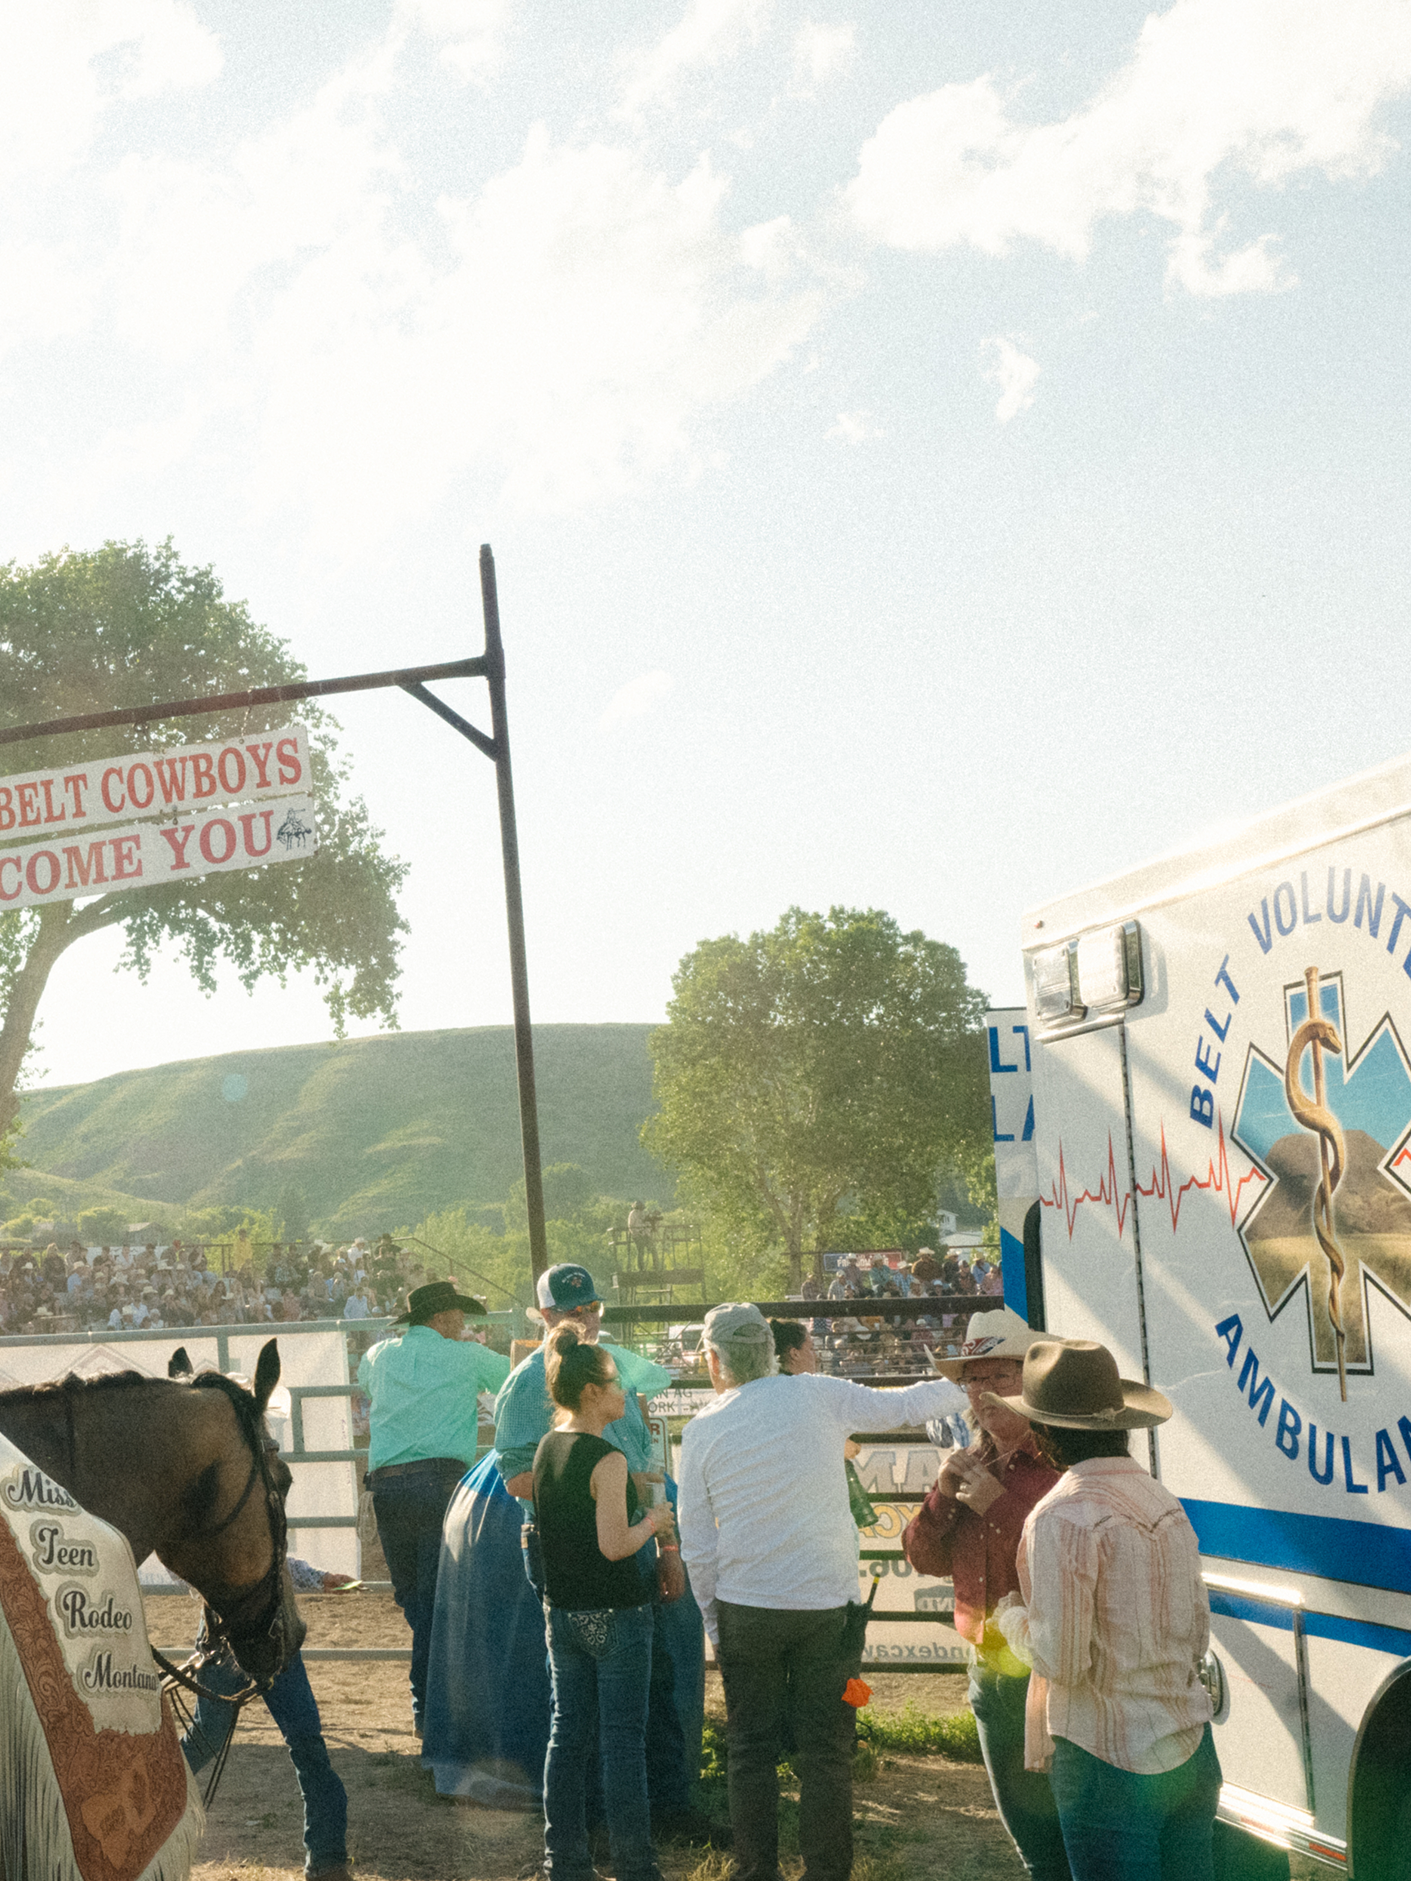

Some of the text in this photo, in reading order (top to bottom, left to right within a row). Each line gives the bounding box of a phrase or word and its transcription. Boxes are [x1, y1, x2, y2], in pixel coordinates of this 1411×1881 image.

[100, 736, 303, 814] COWBOYS
[160, 810, 276, 870] YOU
[1190, 954, 1240, 1129] BELT
[7, 1469, 77, 1508] Miss
[38, 1526, 94, 1567] Teen
[62, 1590, 133, 1630] Rodeo
